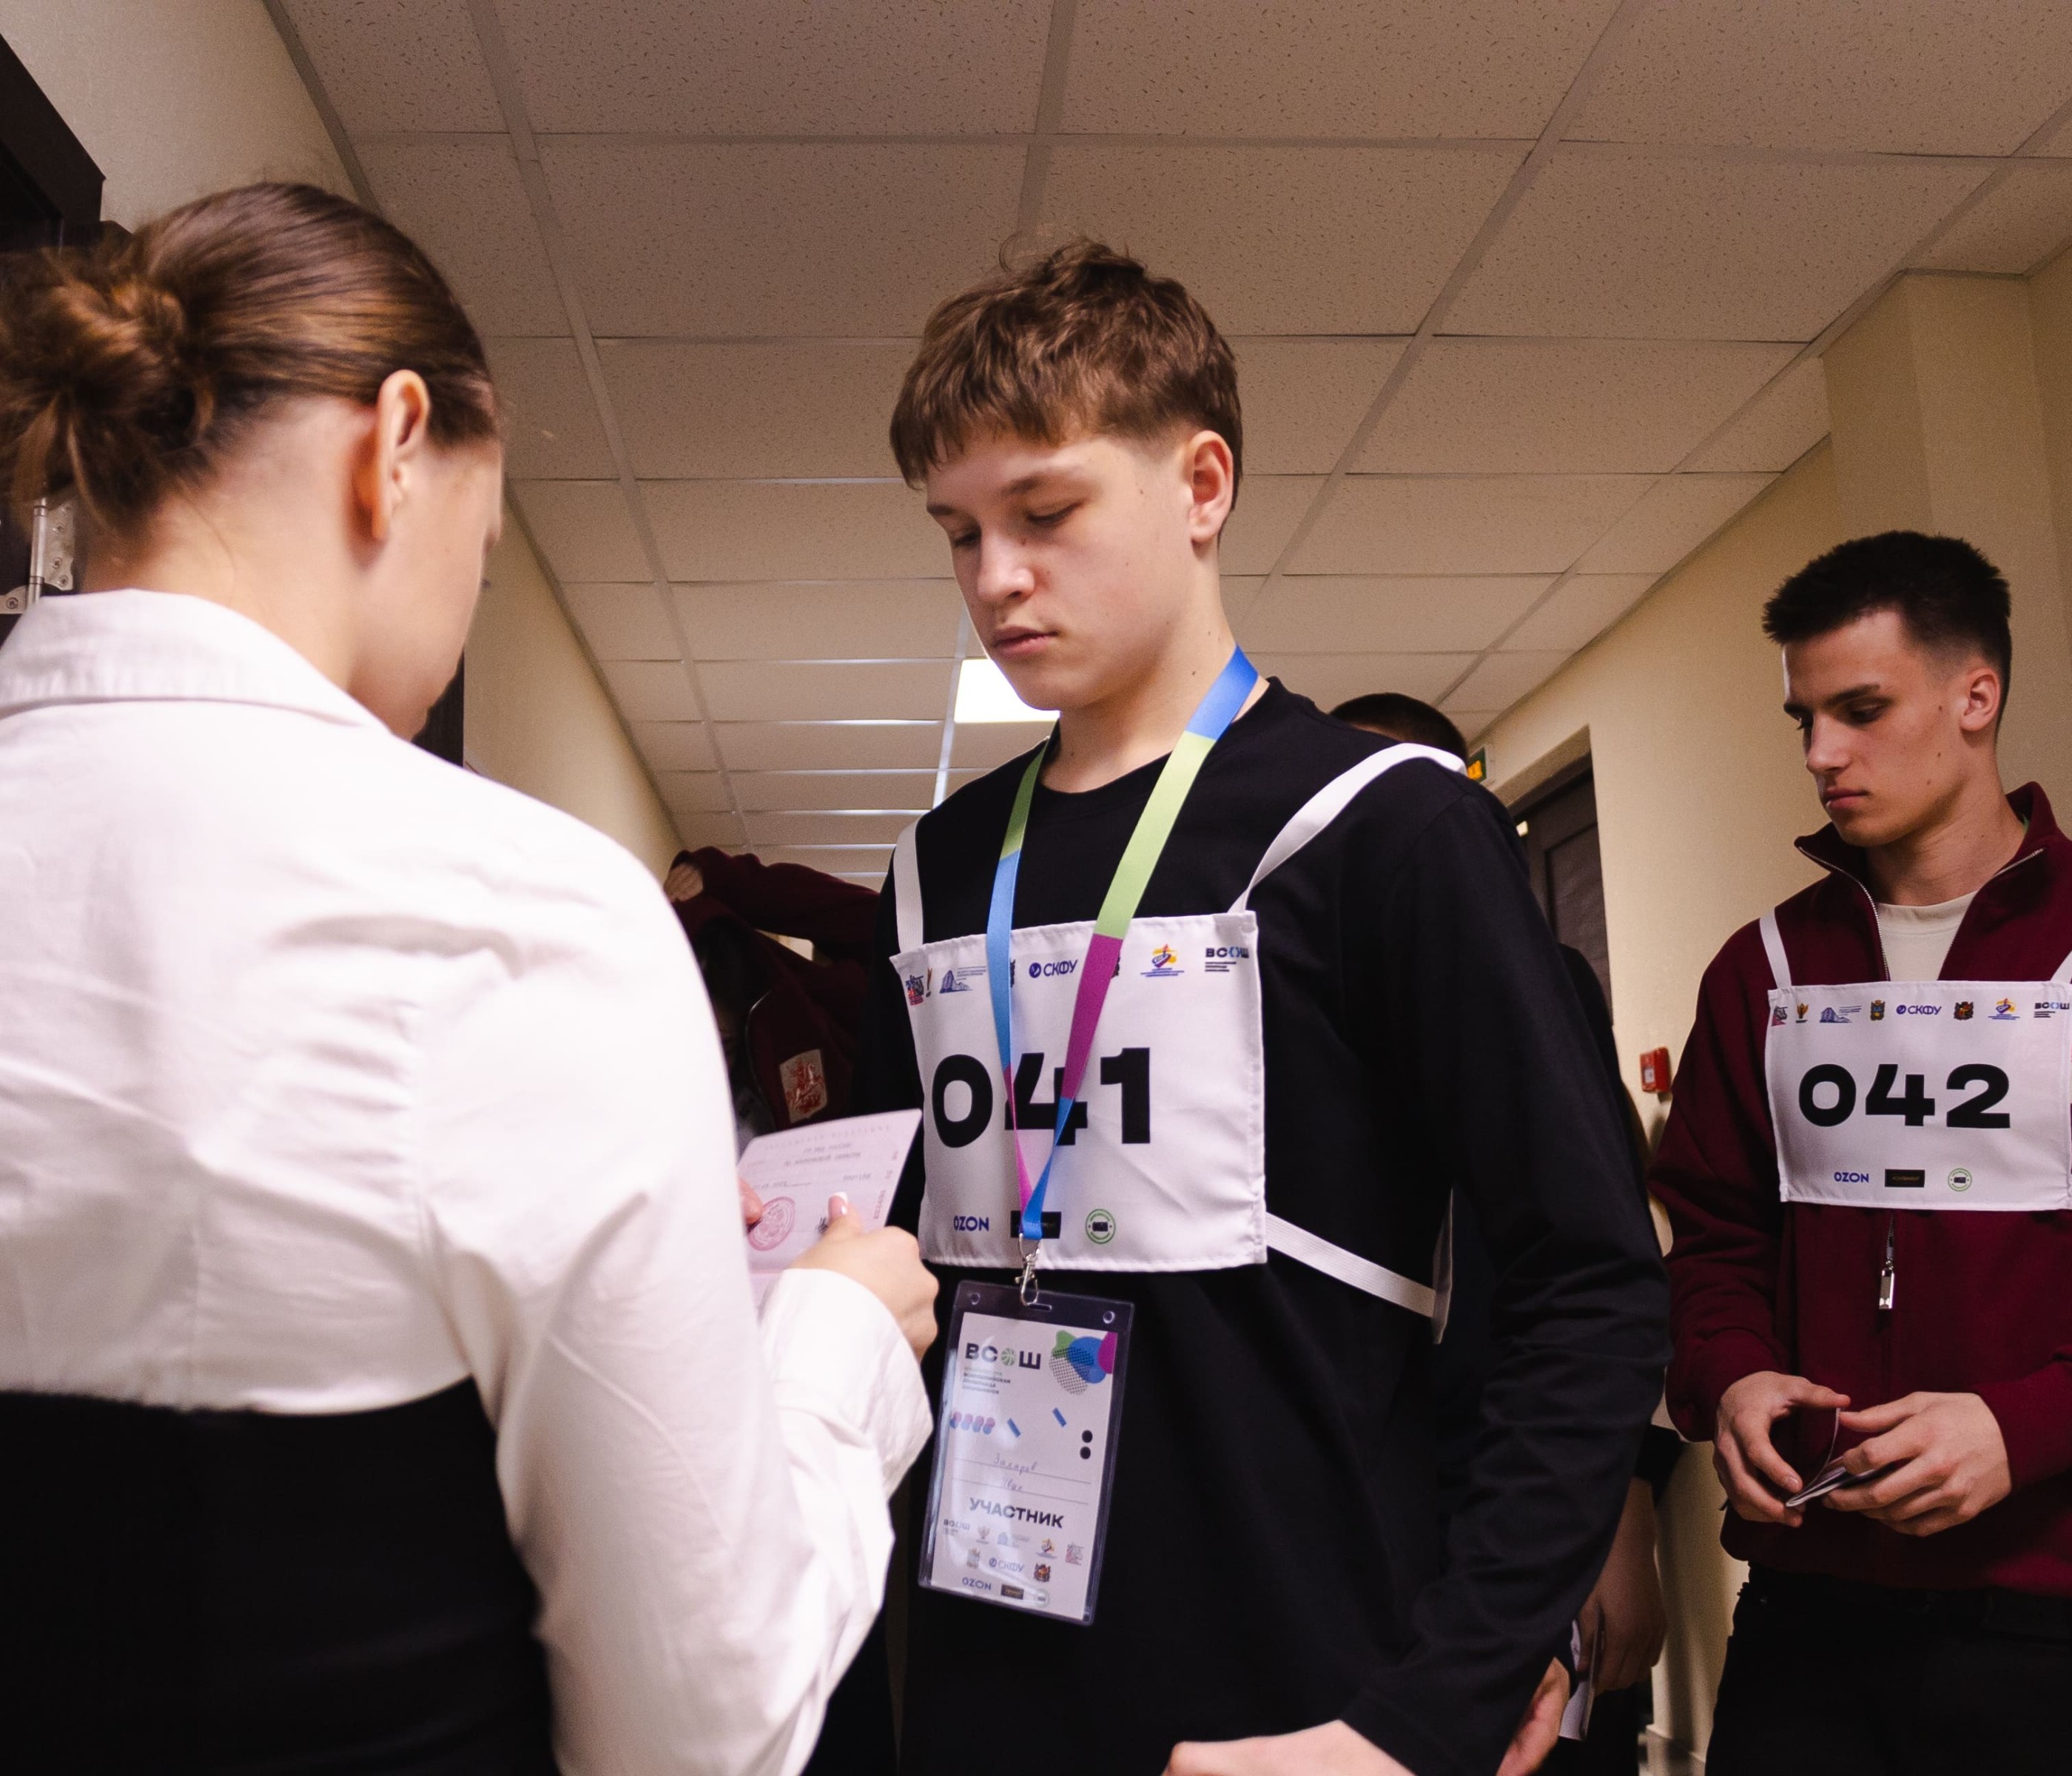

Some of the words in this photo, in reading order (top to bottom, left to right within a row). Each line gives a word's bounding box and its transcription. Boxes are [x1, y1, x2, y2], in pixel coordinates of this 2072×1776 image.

[1043, 958, 1078, 977] СКФУ
[1908, 1005, 1942, 1015] СКФУ
[932, 1047, 1151, 1148] 041
[1798, 1063, 2011, 1129] 042
[1834, 1171, 1869, 1183] OZON
[953, 1215, 989, 1232] OZON
[969, 1497, 1064, 1528] УЧАСТНИК
[961, 1577, 992, 1590] OZON
